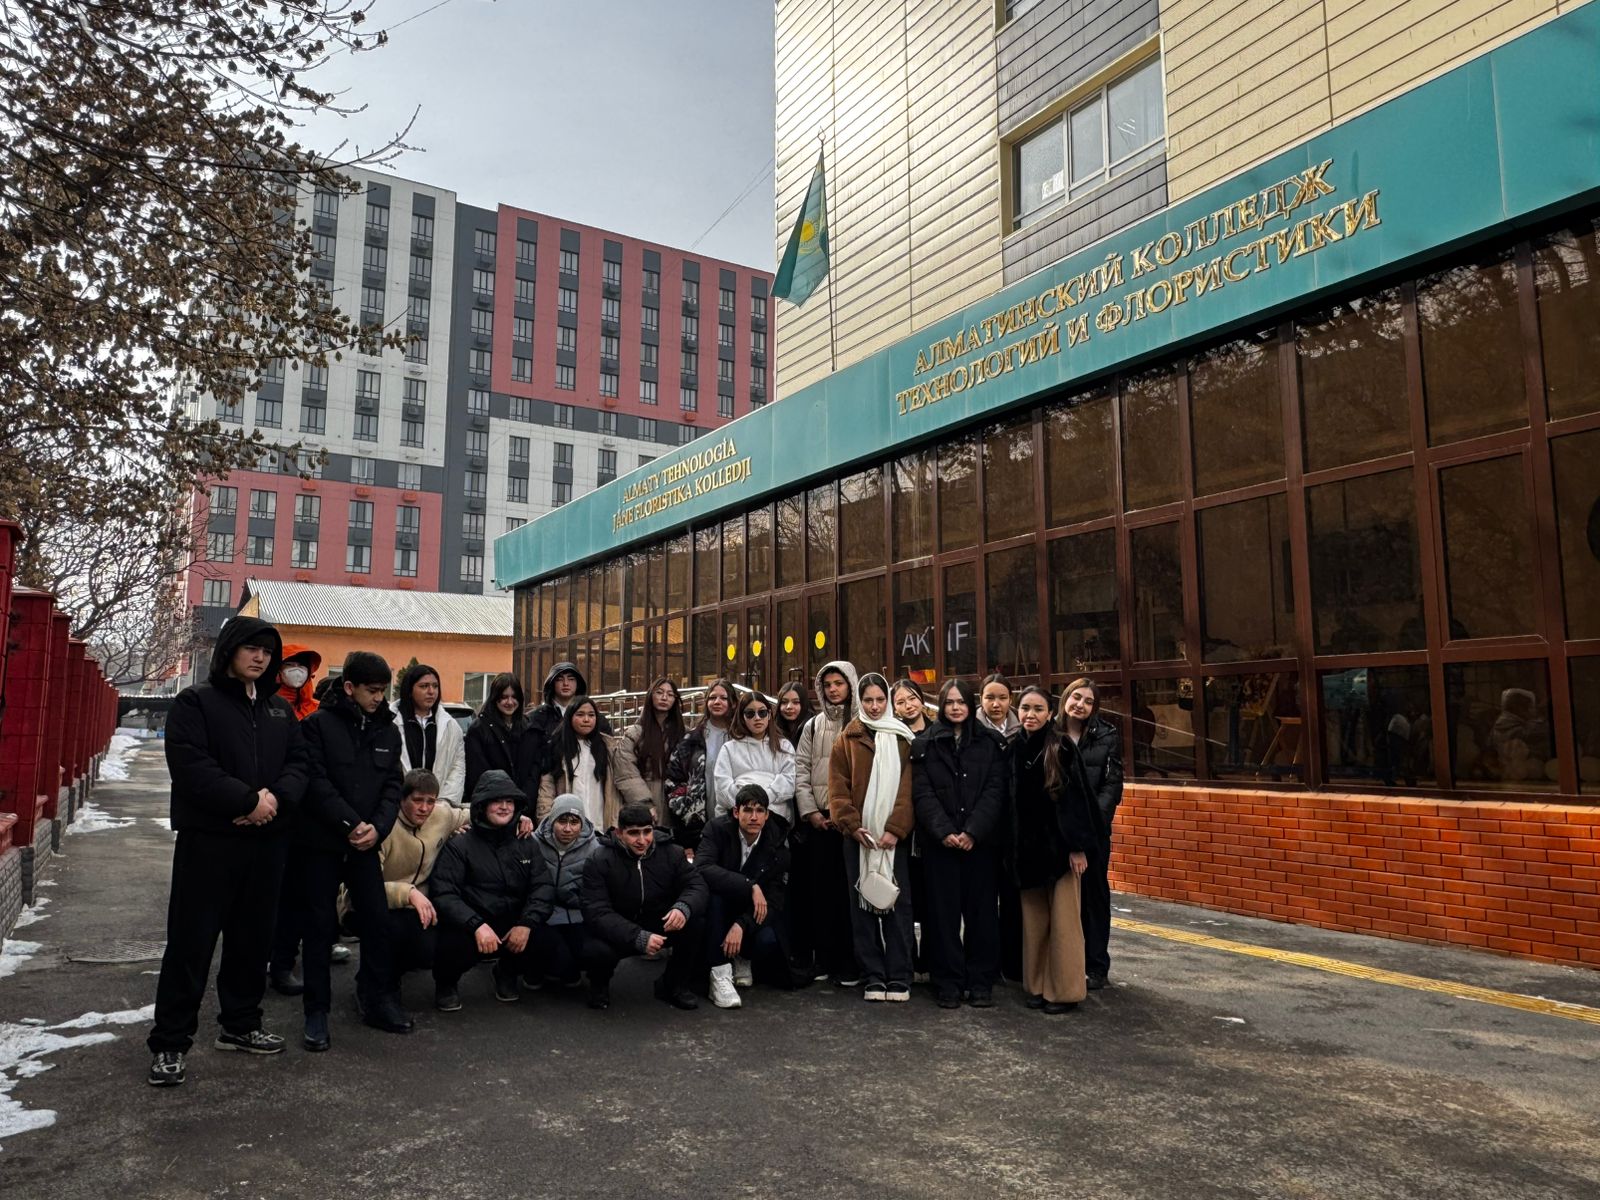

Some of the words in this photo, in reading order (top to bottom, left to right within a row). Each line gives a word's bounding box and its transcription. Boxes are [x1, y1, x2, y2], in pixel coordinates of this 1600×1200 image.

[895, 321, 1061, 416] ТЕХНОЛОГИЙ
[1067, 312, 1090, 346] И
[1095, 188, 1382, 334] ФЛОРИСТИКИ
[913, 252, 1126, 377] АЛМАТИНСКИЙ
[1130, 157, 1336, 280] КОЛЛЕДЖ
[622, 471, 662, 504] ALMATY
[634, 484, 693, 522] FLORISTIKA
[694, 456, 753, 498] KOLLEDJI
